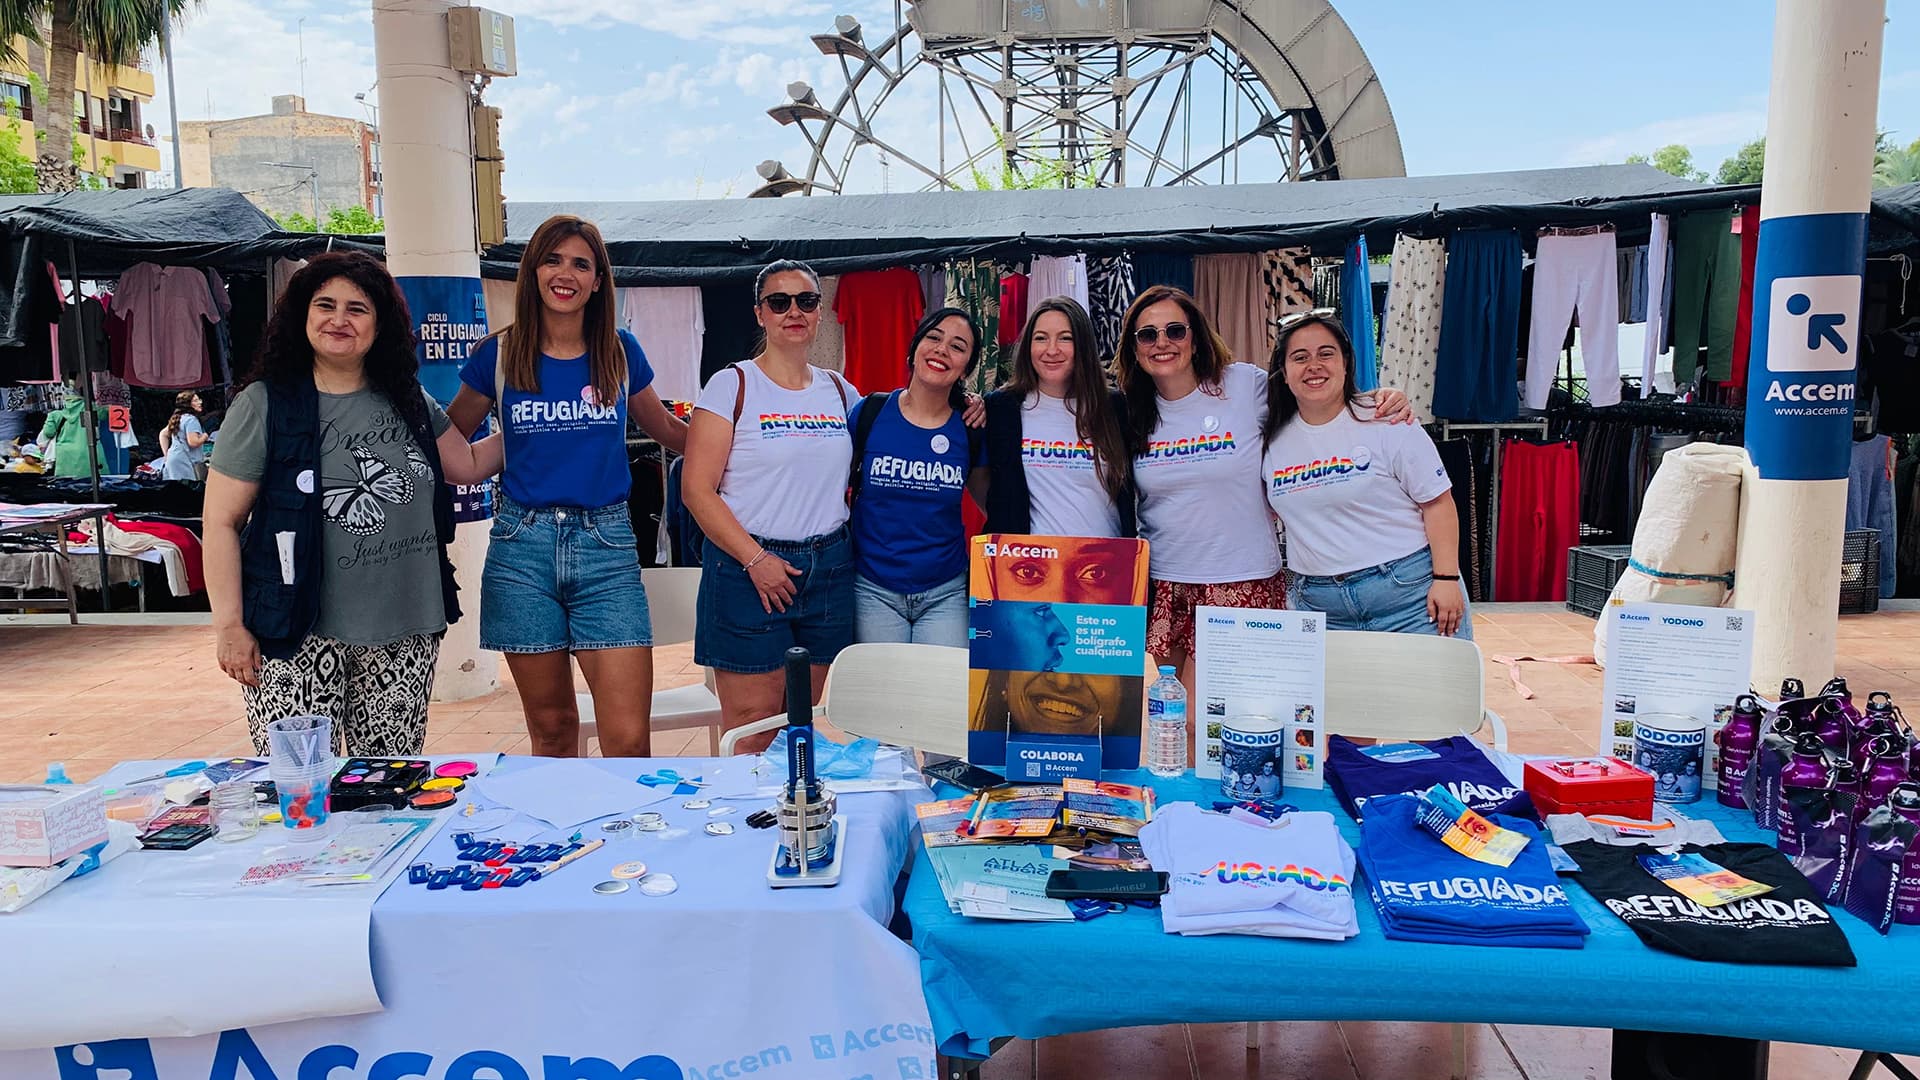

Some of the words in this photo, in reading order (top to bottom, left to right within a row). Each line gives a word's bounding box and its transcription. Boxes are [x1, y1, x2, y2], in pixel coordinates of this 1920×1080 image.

[427, 313, 448, 322] CICLO
[421, 323, 487, 340] REFUGIADOS
[425, 342, 445, 359] EN
[448, 342, 464, 359] EL
[1764, 380, 1855, 401] Accem
[110, 408, 127, 430] 3
[511, 400, 618, 424] REFUGIADA
[1774, 407, 1848, 416] www.accem.es
[1021, 438, 1106, 462] EFUGIAD
[870, 455, 964, 486] REFUGIADA
[1000, 543, 1058, 559] Accem
[1076, 615, 1099, 625] Este
[1102, 616, 1117, 625] no
[1245, 620, 1282, 630] YODONO
[1662, 616, 1704, 627] YODONO
[1076, 627, 1088, 635] es
[1091, 627, 1104, 636] un
[1075, 646, 1133, 658] cualquiera
[1636, 725, 1703, 744] YODONO
[1020, 750, 1084, 762] COLABORA
[1052, 764, 1078, 772] Accem
[984, 857, 1049, 872] ATLAS
[1200, 861, 1352, 894] UGIADA
[1605, 894, 1829, 921] REFUGIADA
[845, 1022, 934, 1056] Accem
[688, 1044, 792, 1080] Accem
